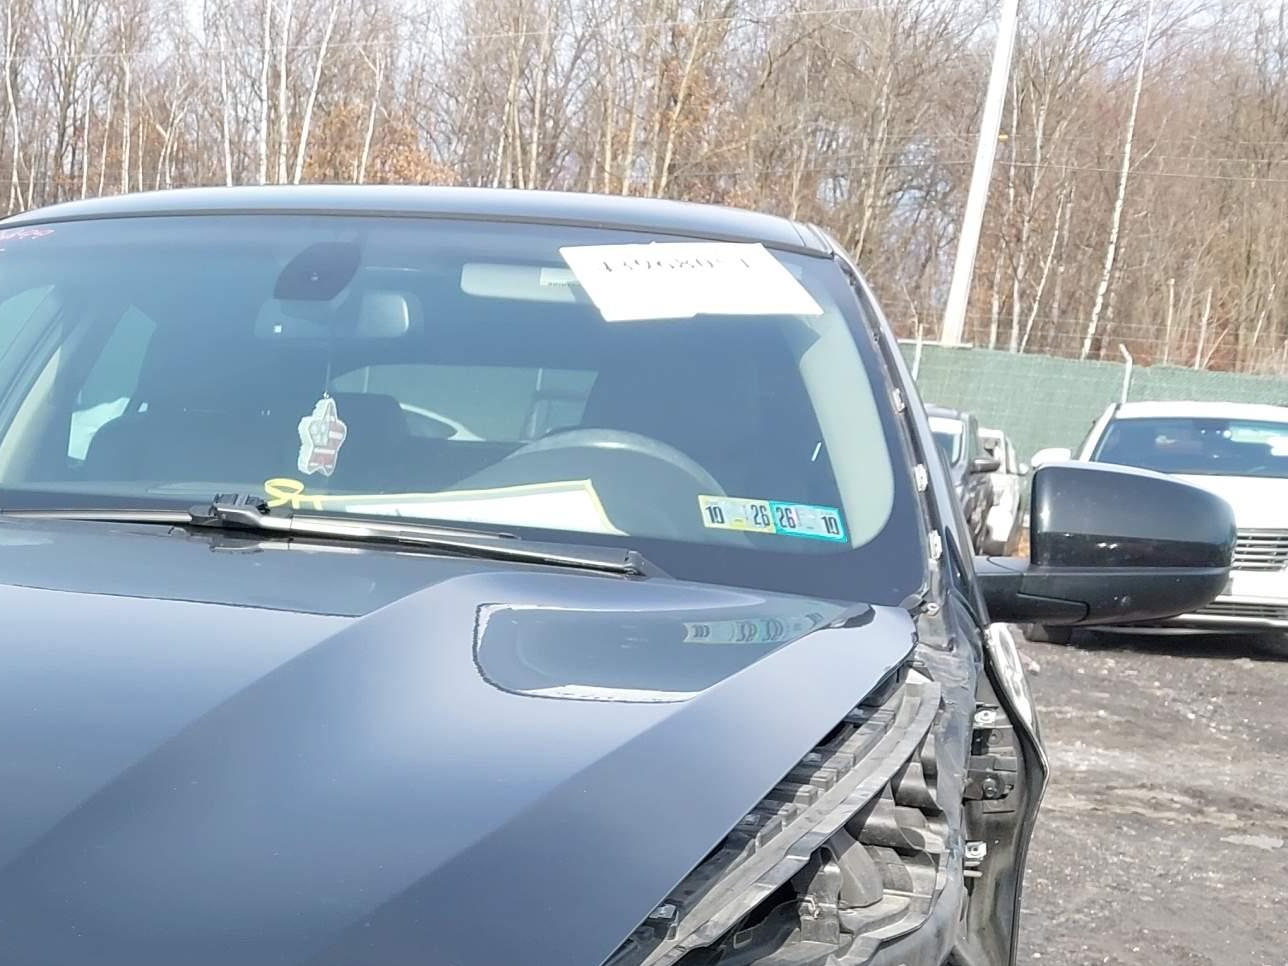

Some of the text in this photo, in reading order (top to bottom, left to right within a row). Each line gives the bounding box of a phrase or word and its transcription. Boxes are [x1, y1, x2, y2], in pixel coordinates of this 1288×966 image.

[705, 504, 770, 527] 10 26
[775, 506, 841, 535] 26 10
